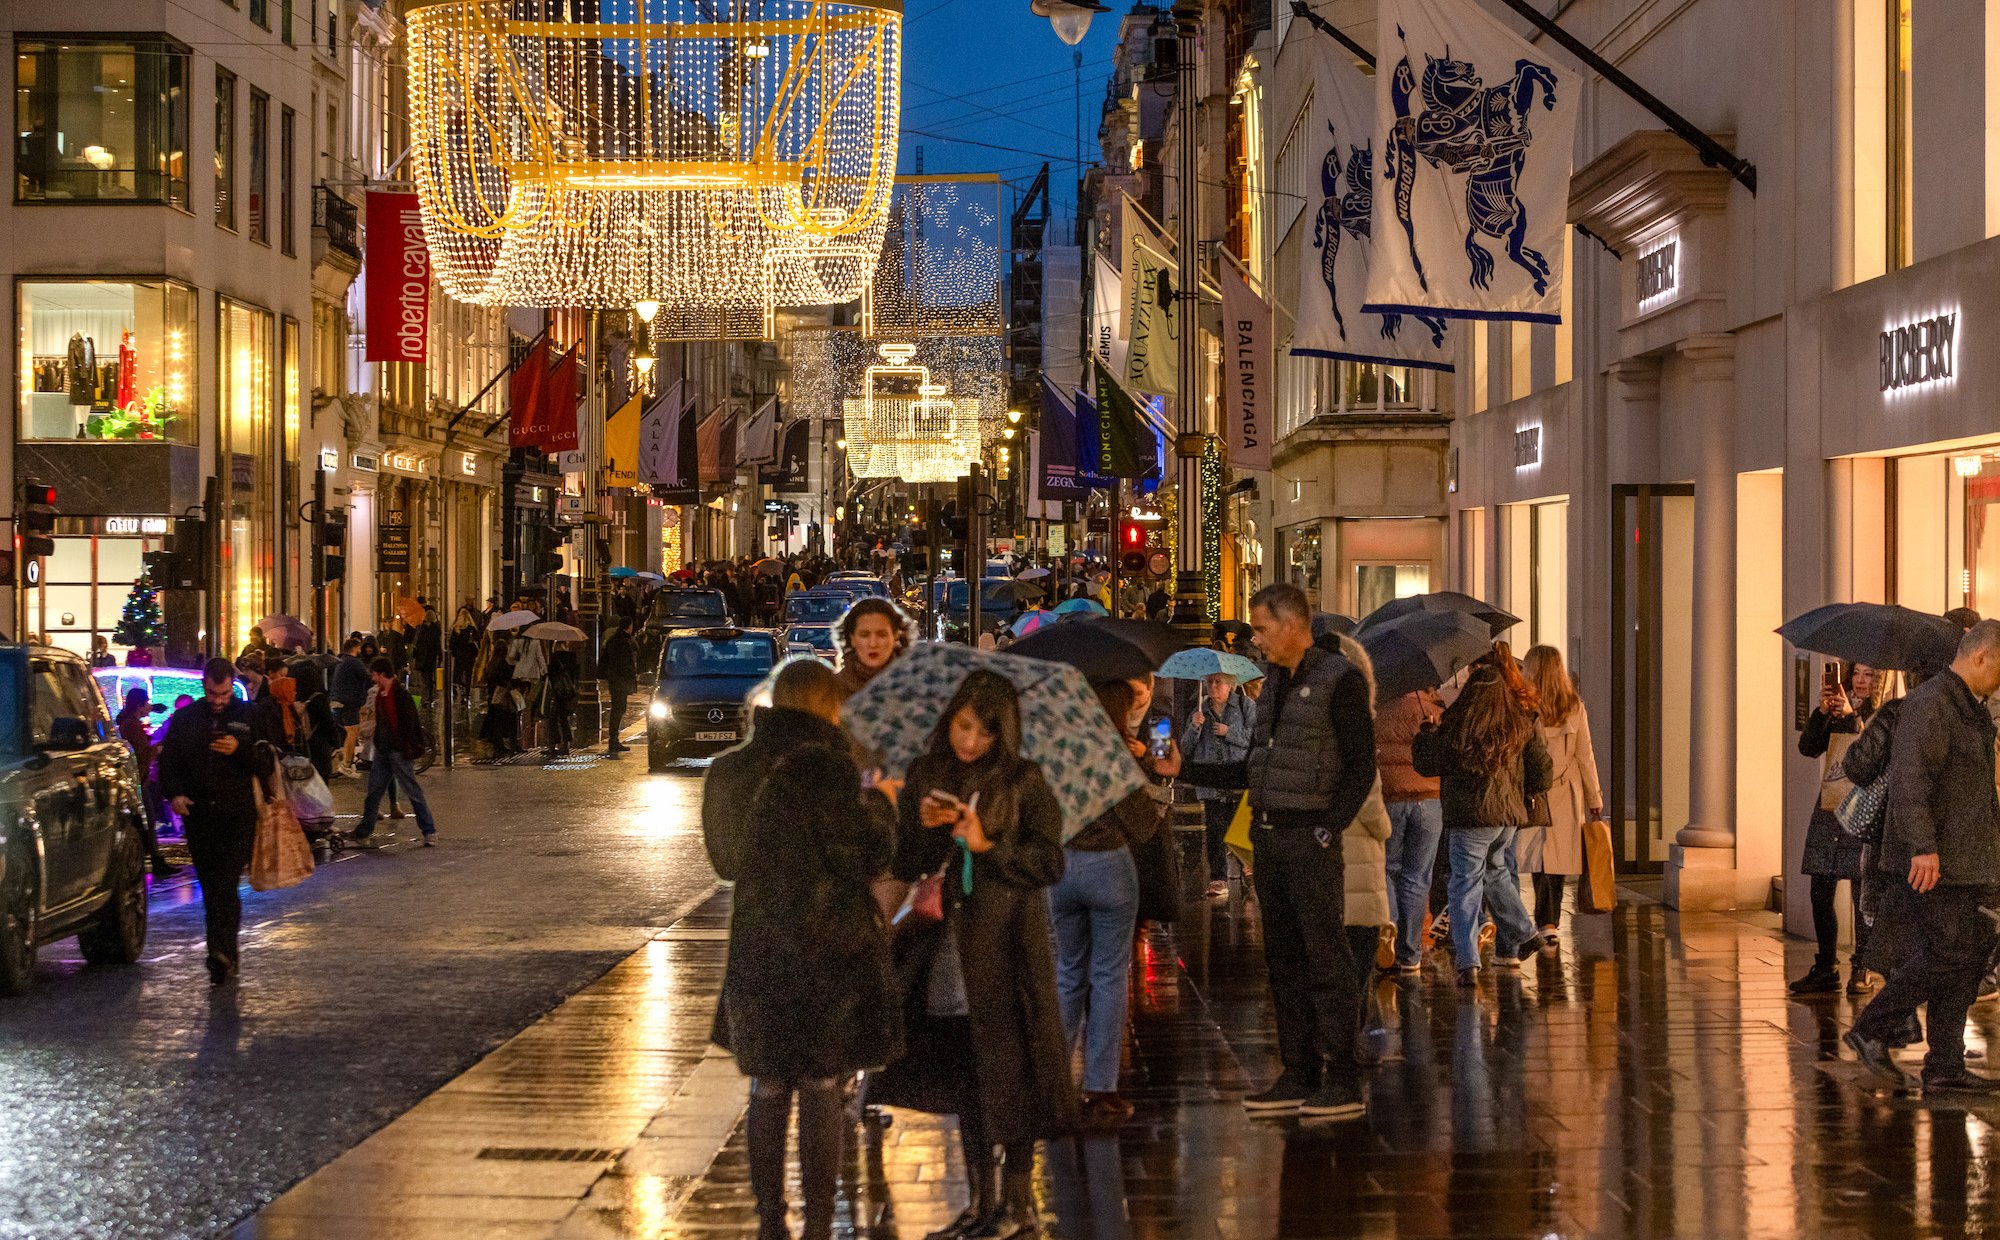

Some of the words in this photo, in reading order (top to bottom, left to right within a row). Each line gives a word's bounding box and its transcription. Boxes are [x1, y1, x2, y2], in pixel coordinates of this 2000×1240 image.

[400, 209, 427, 278] cavalli
[397, 282, 425, 358] roberto
[1130, 267, 1157, 385] AQUAZZURA
[1880, 312, 1956, 391] BURBERRY
[1238, 320, 1257, 449] BALENCIAGA
[512, 424, 550, 435] GUCCI
[1099, 377, 1112, 470] LONGCHAMP
[1046, 476, 1084, 488] ZEGN
